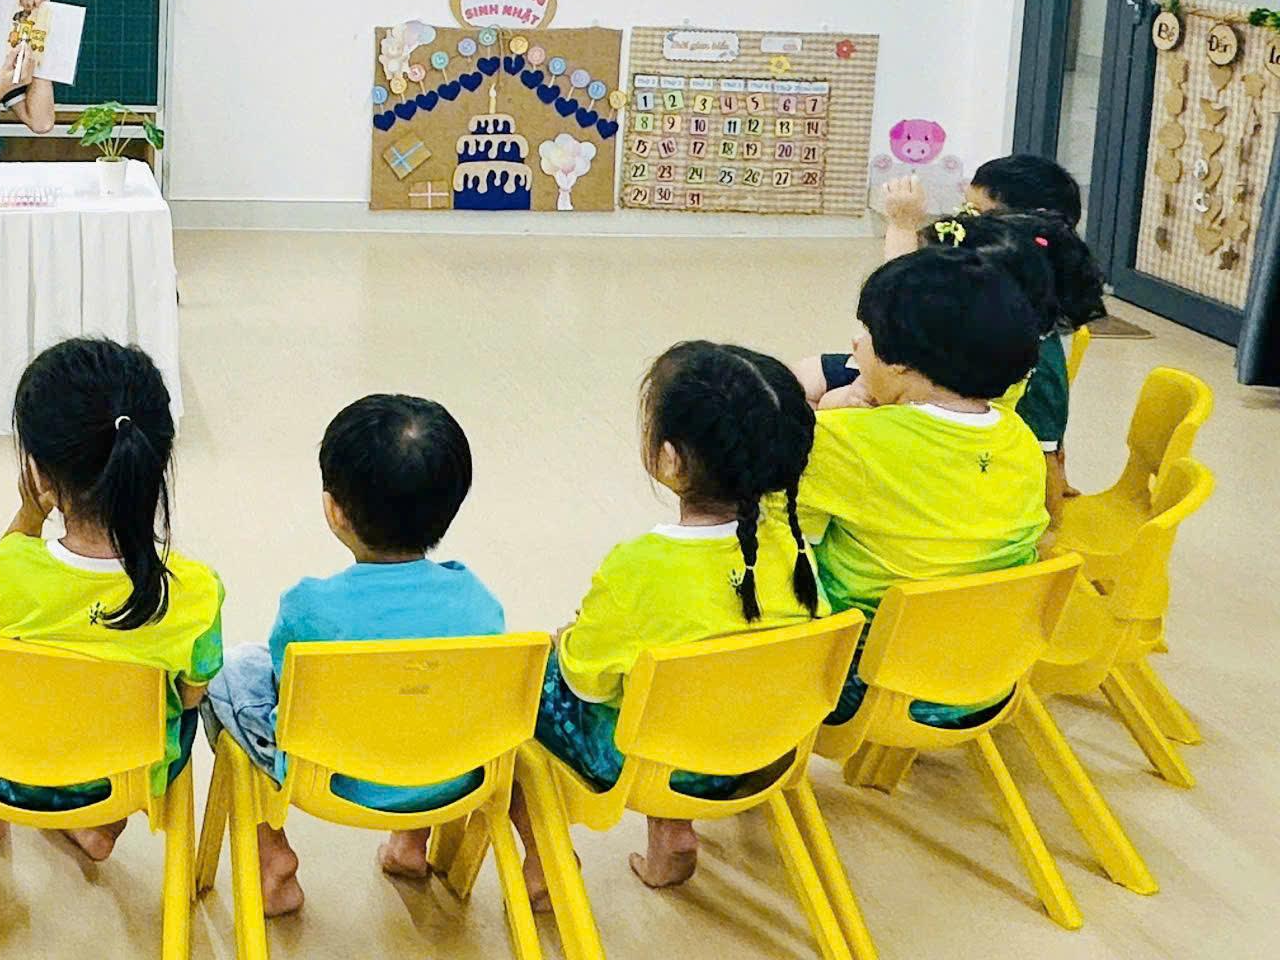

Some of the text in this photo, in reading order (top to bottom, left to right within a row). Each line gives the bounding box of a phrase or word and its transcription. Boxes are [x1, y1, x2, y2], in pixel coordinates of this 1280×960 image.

[465, 4, 540, 25] SINH NHẬT
[642, 95, 818, 112] 1 2 3 4 5 6 7
[641, 116, 818, 135] 8 9 10 11 12 13 14
[636, 140, 816, 160] 15 16 17 18 19 20 21
[632, 164, 818, 186] 22 23 24 25 26 27 28
[632, 187, 701, 206] 29 30 31
